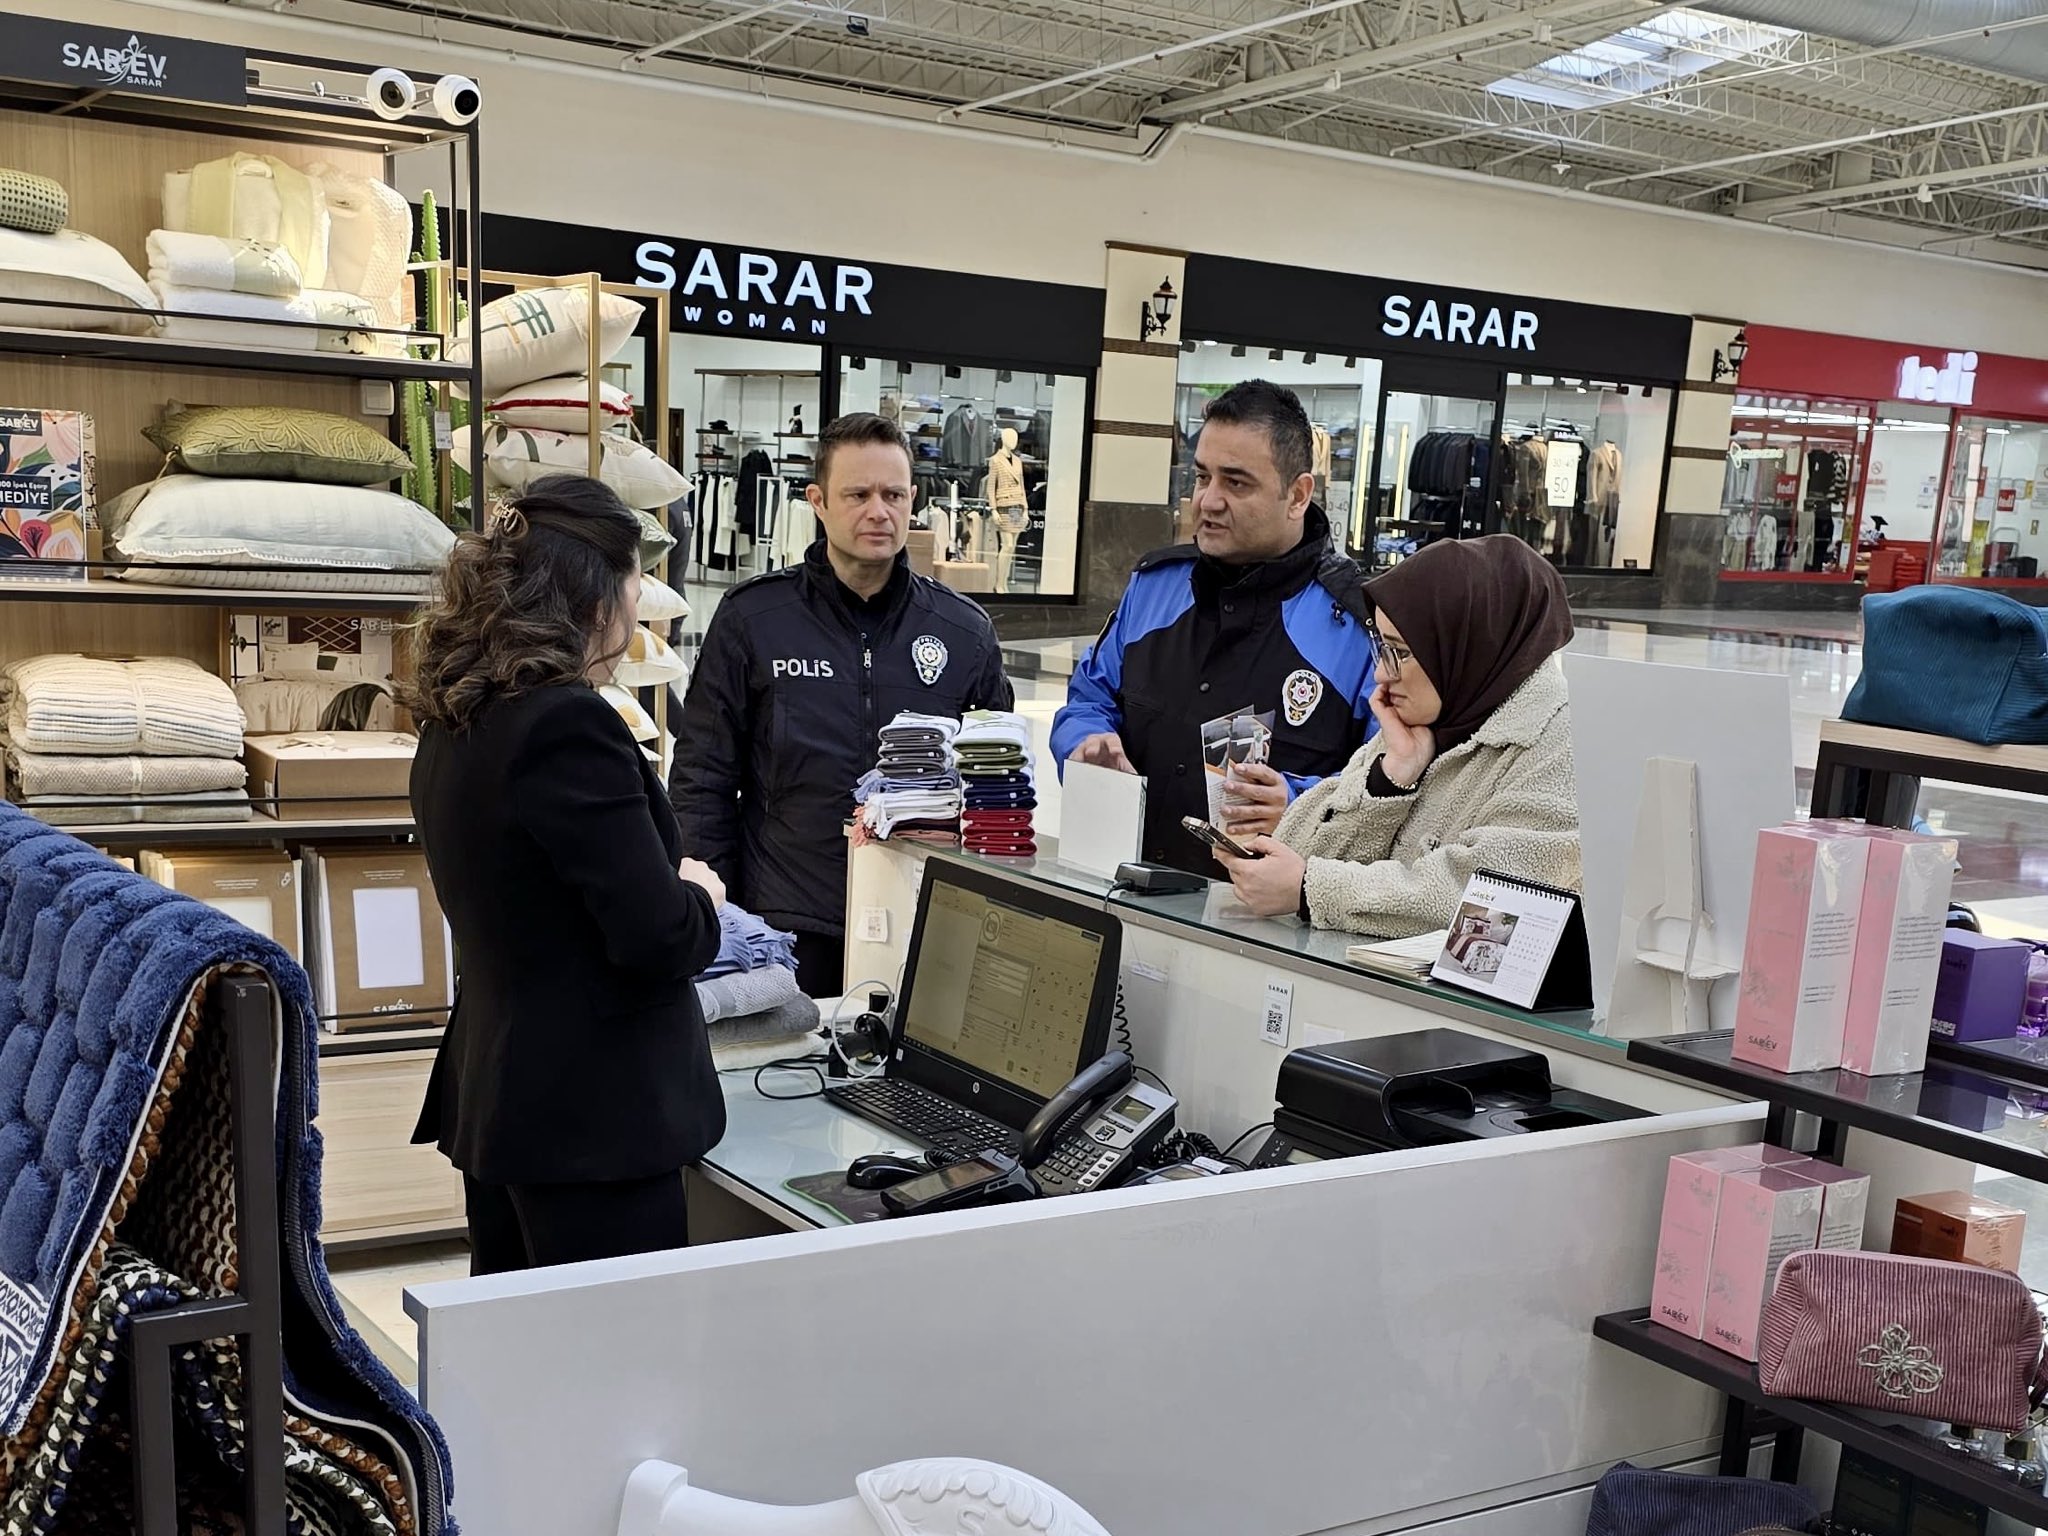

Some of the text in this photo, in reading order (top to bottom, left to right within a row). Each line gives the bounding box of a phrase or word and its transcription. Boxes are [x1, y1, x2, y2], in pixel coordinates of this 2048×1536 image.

[126, 75, 162, 88] SARAR
[634, 241, 874, 316] SARAR
[683, 305, 827, 336] WOMAN
[1381, 294, 1540, 351] SARAR
[1553, 476, 1569, 493] 50
